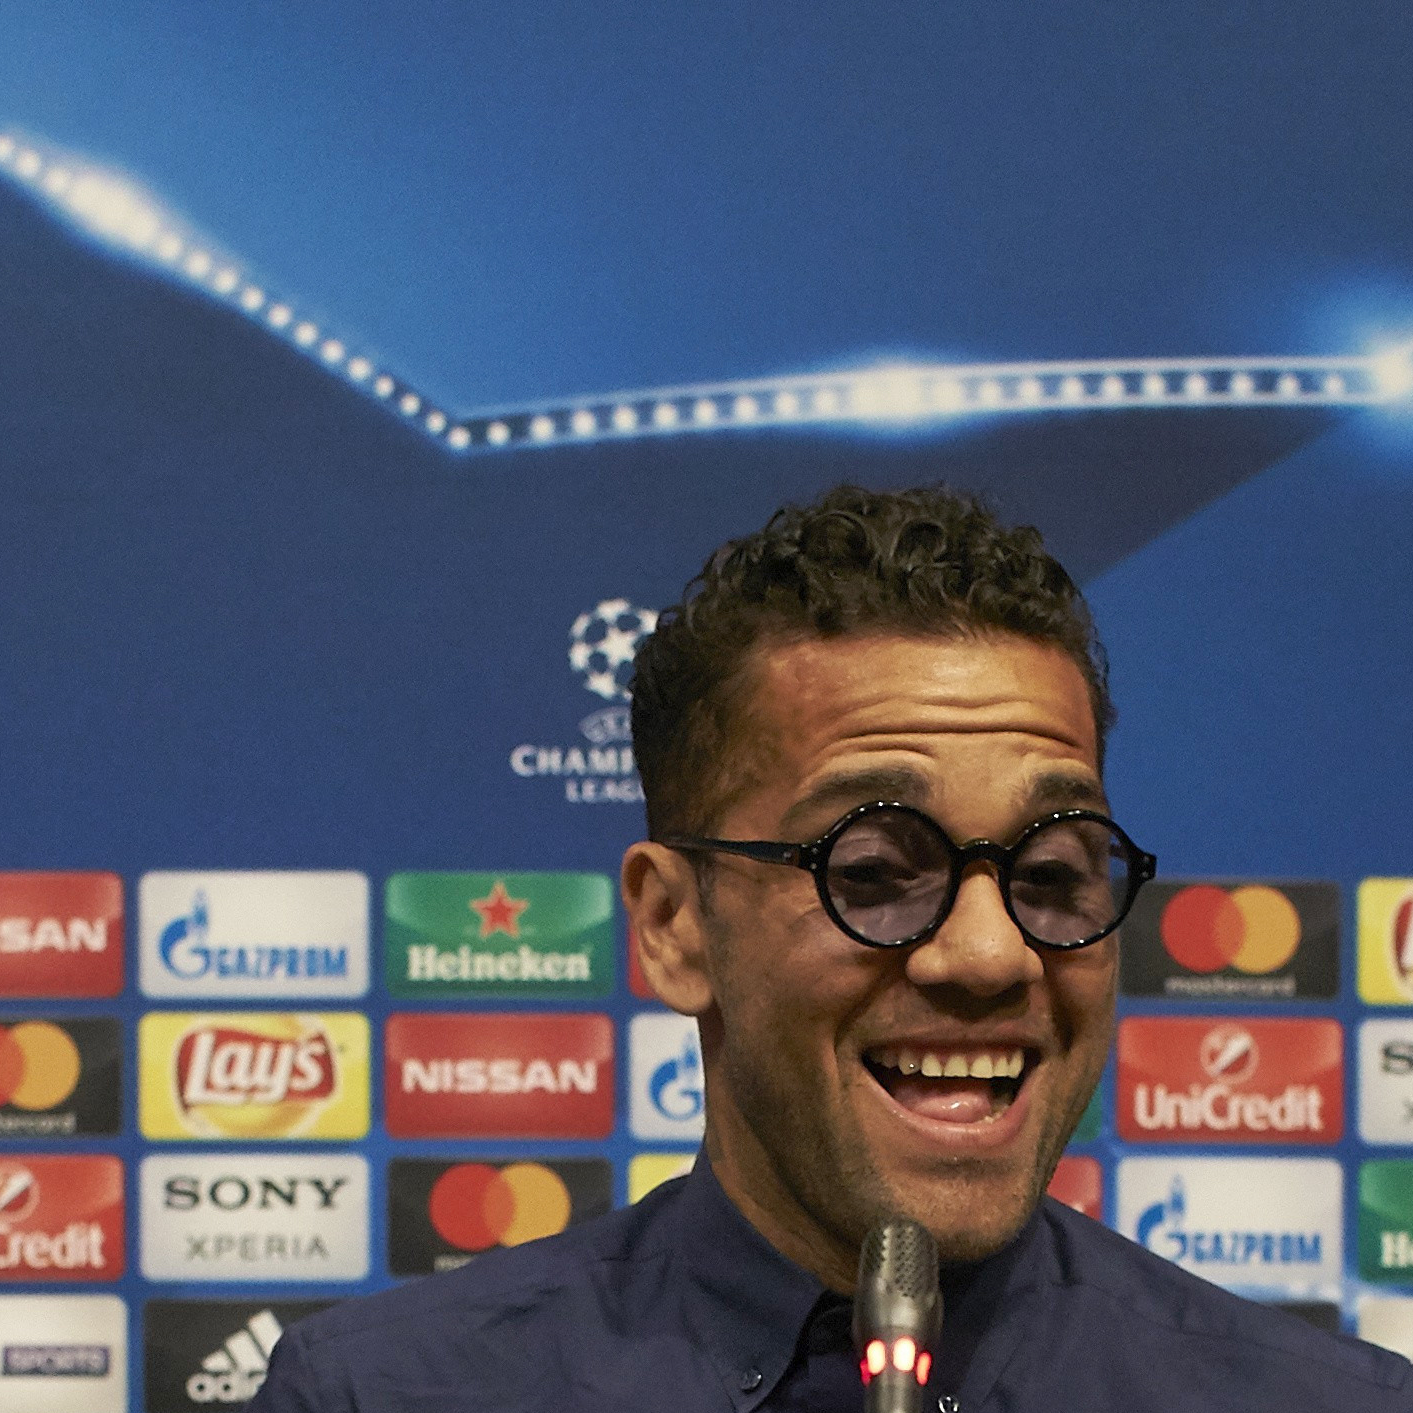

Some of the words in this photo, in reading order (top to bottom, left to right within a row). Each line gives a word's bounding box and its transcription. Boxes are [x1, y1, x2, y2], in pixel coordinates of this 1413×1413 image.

[213, 946, 347, 979] GAZPROM
[407, 944, 591, 983] Heineken
[401, 1058, 597, 1095] NISSAN
[1134, 1084, 1323, 1133] UniCredit
[164, 1176, 347, 1214] SONY
[186, 1232, 331, 1262] XPERIA
[1193, 1231, 1322, 1266] GAZPROM
[187, 1371, 268, 1403] adi
